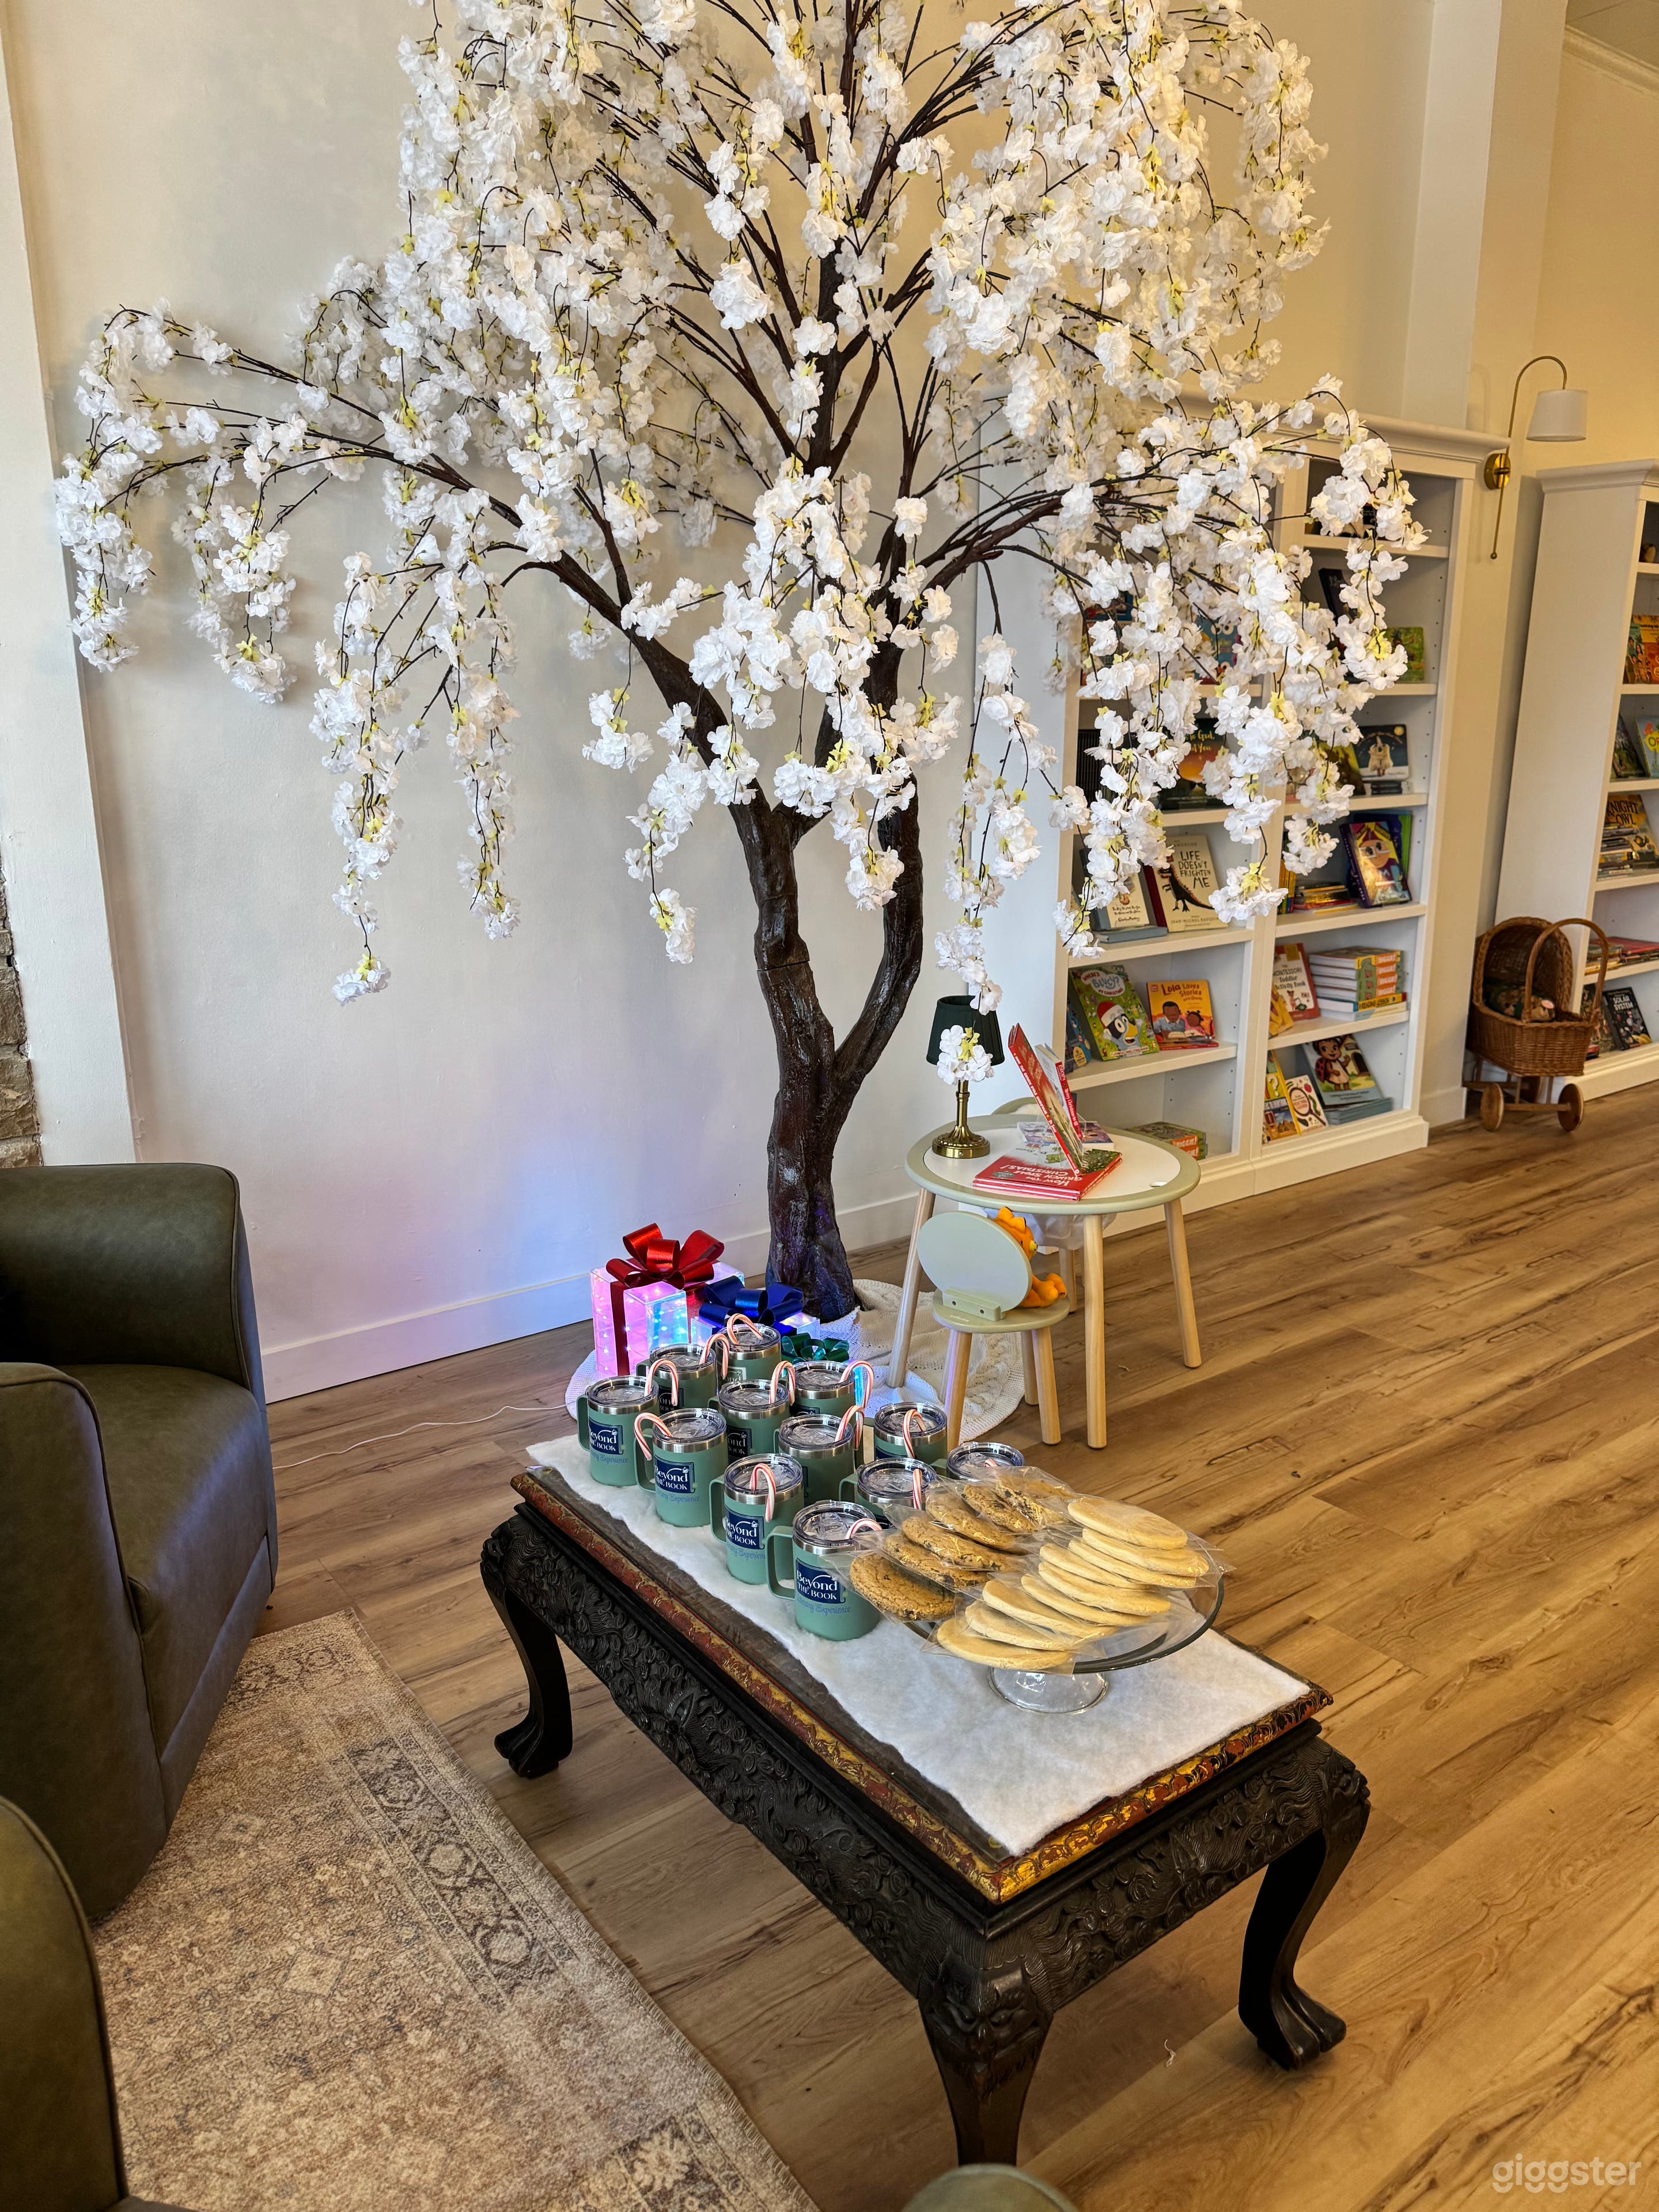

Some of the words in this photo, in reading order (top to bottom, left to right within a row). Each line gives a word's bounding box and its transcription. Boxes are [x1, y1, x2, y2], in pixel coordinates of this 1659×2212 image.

[1615, 813, 1636, 826] OWL
[1180, 850, 1200, 861] LIFE
[1180, 869, 1210, 877] FRIGHTEN
[1193, 877, 1210, 889] ME
[1161, 984, 1181, 995] Lola
[1179, 988, 1202, 997] Stories
[1613, 1002, 1634, 1011] SYSTEM
[1000, 1165, 1068, 1175] CHRISTMAS!
[597, 1442, 616, 1451] BOOK
[655, 1465, 688, 1482] Beyond
[666, 1482, 687, 1490] BOOK
[734, 1535, 756, 1546] BOOK
[797, 1570, 838, 1591] Beyond
[797, 1581, 810, 1595] THE
[811, 1589, 837, 1600] BOOK
